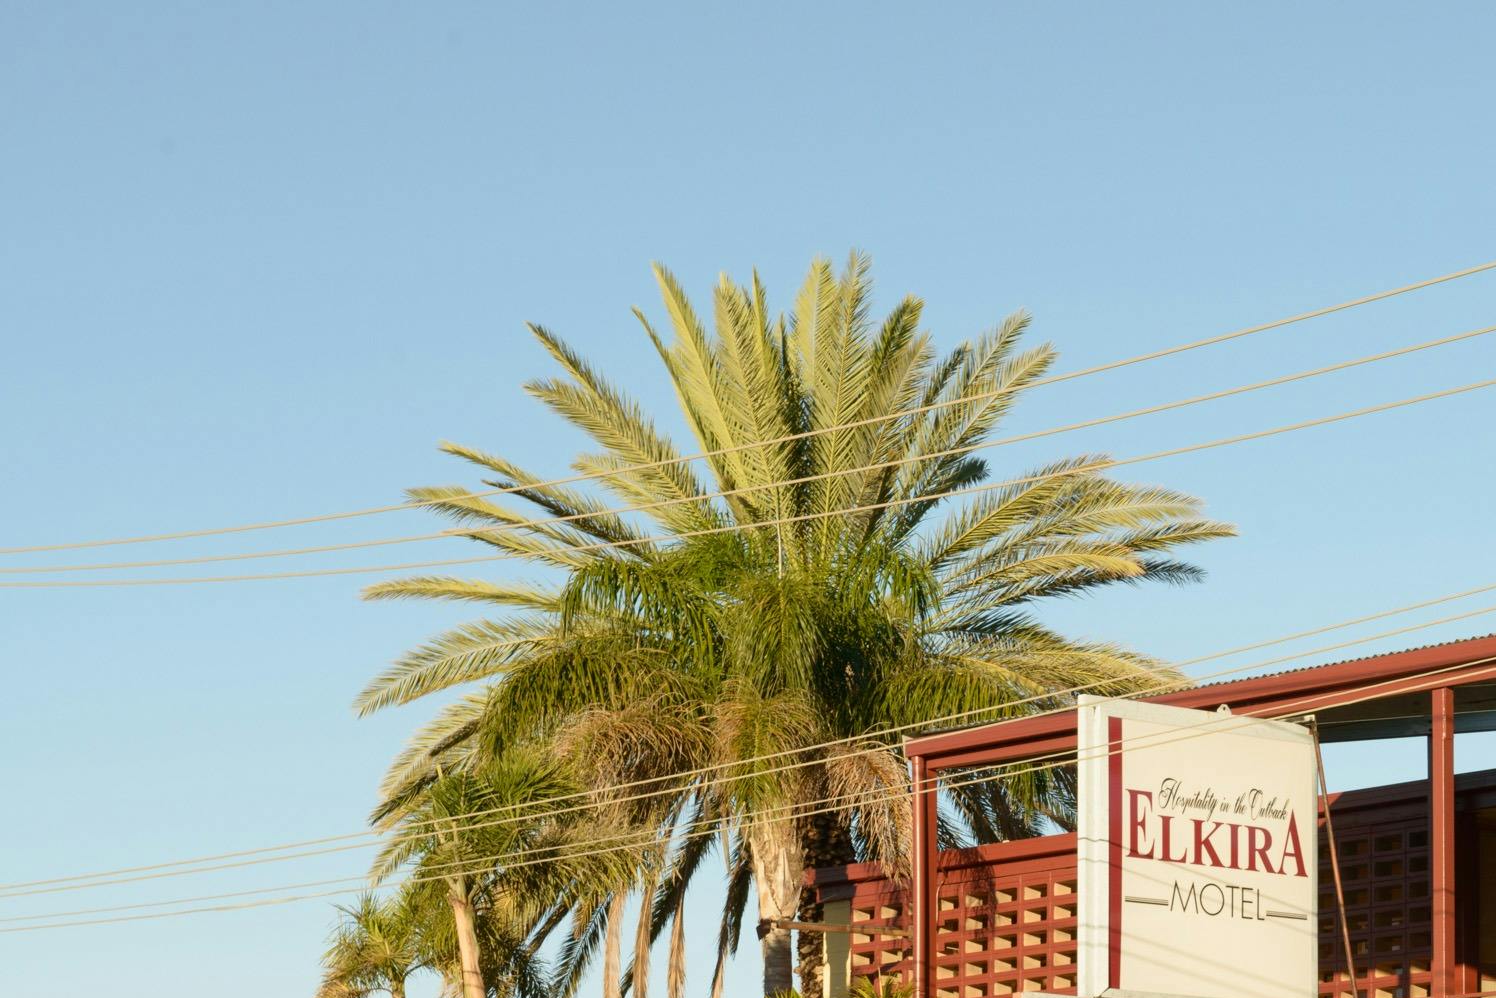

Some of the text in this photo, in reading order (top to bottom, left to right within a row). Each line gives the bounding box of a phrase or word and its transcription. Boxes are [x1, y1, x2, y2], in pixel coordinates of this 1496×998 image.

[1158, 777, 1290, 822] Hospitality in the Outback
[1125, 788, 1308, 878] ELKIRA
[1170, 880, 1265, 921] MOTEL
